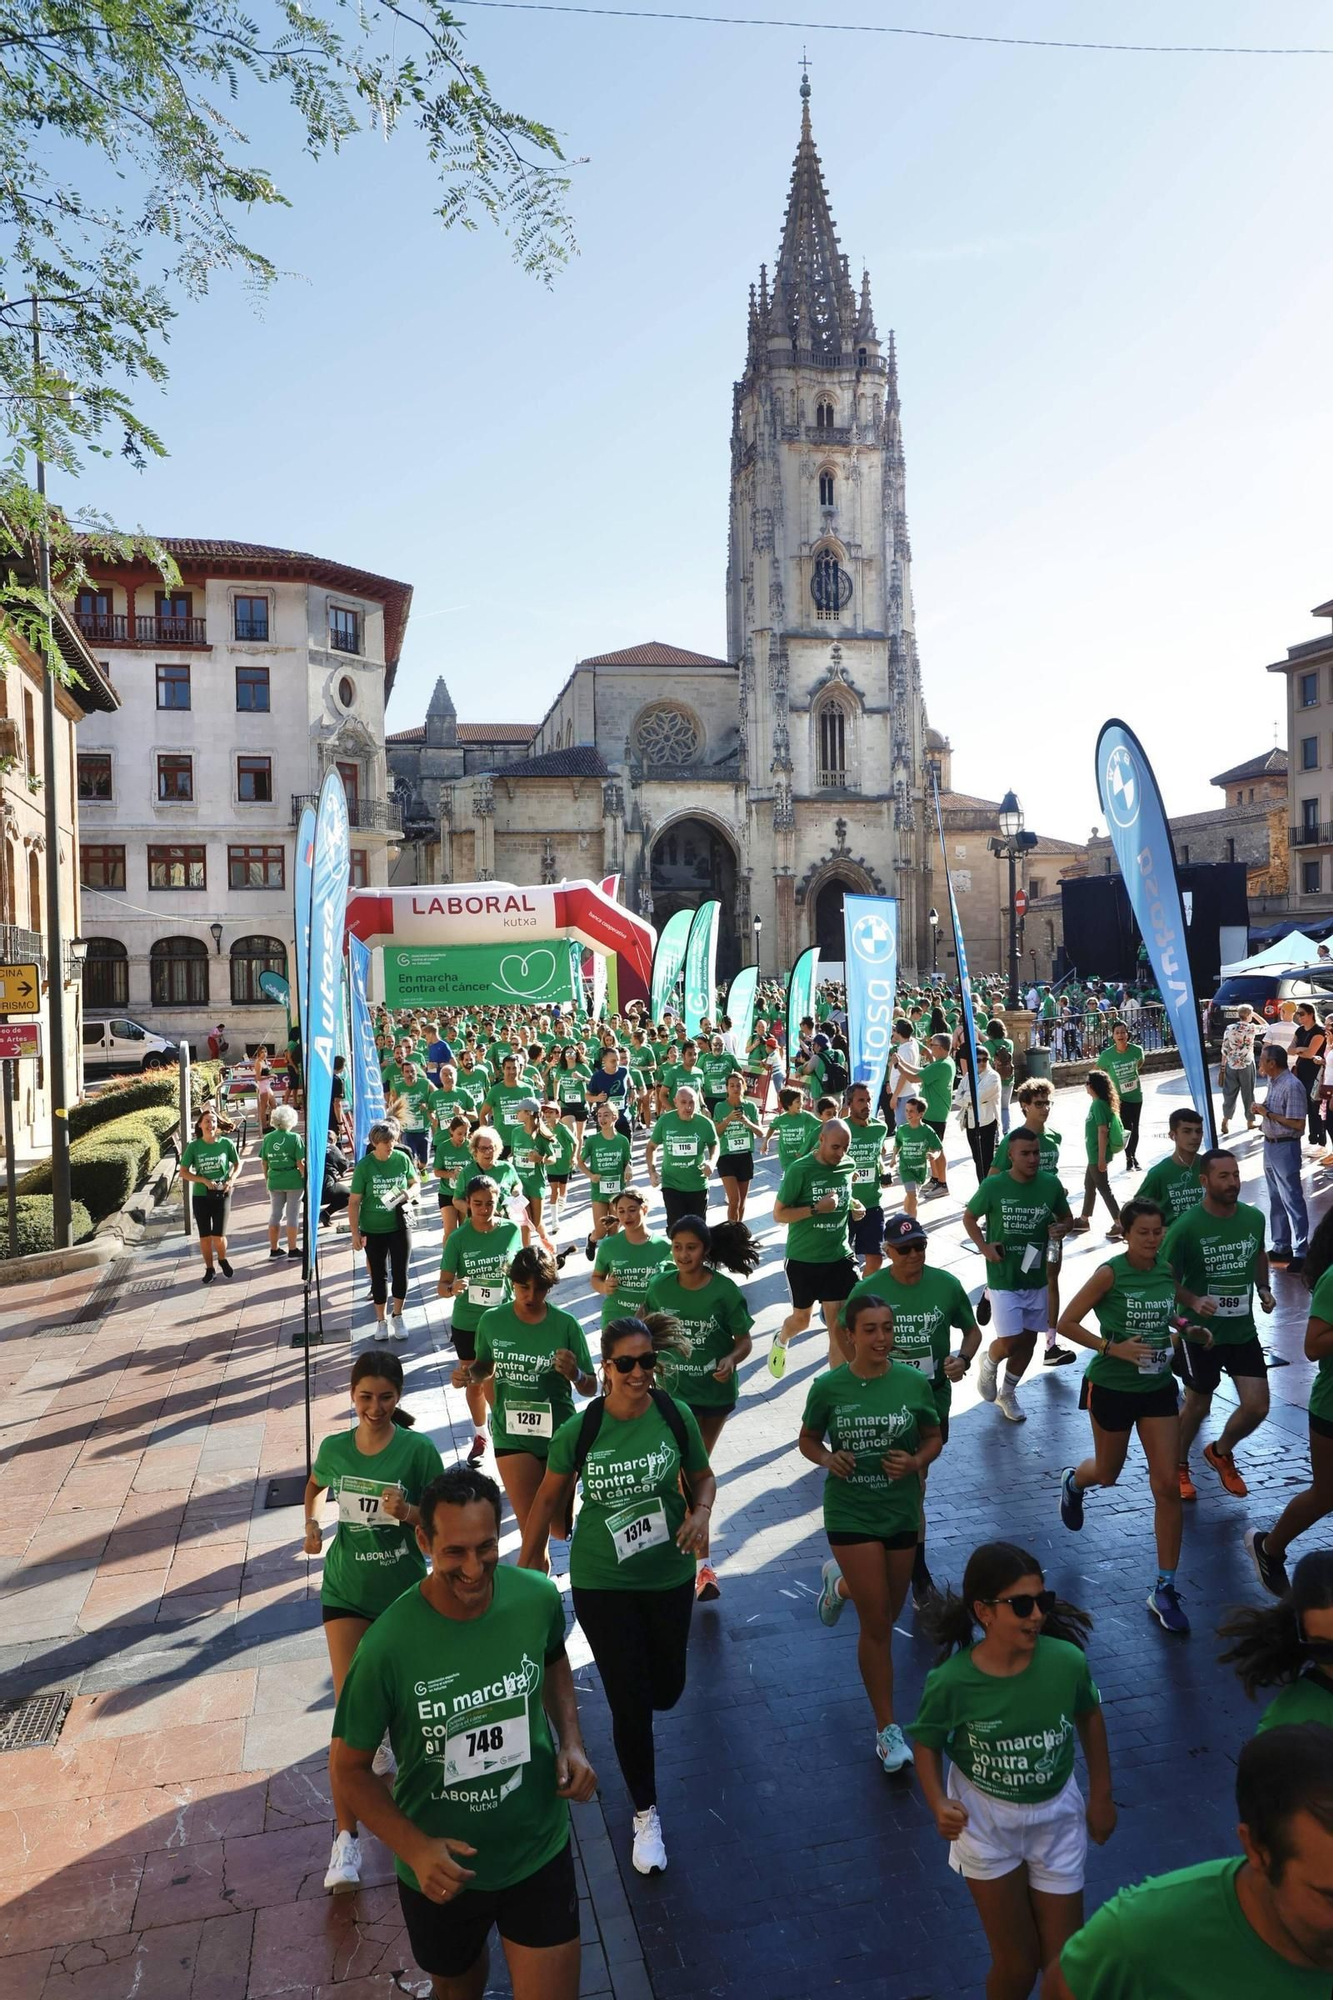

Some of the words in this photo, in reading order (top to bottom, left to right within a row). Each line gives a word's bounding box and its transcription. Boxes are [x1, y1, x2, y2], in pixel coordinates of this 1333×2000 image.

[412, 894, 536, 915] LABORAL
[503, 916, 537, 928] kutxa
[398, 973, 413, 983] En
[415, 972, 459, 983] marcha
[314, 897, 335, 1078] Autosa
[398, 984, 436, 994] contra
[438, 982, 449, 992] el
[452, 981, 490, 992] cáncer
[0, 1000, 35, 1011] RISMO
[862, 979, 892, 1084] utosa
[361, 1020, 388, 1124] utosa
[812, 1187, 824, 1195] En
[1169, 1190, 1181, 1198] En
[1171, 1196, 1196, 1205] contra
[1002, 1205, 1013, 1213] En
[1002, 1213, 1027, 1221] contra
[1010, 1220, 1037, 1230] cáncer
[1202, 1246, 1216, 1255] En
[1218, 1240, 1252, 1251] marcha
[464, 1259, 476, 1268] En
[1204, 1253, 1235, 1264] contra
[466, 1265, 493, 1275] contra
[1205, 1264, 1214, 1272] el
[1215, 1260, 1248, 1271] cáncer
[621, 1280, 649, 1288] cáncer
[480, 1288, 491, 1298] 75
[1126, 1298, 1142, 1310] En
[1218, 1297, 1240, 1308] 369
[896, 1312, 937, 1323] marcha
[1126, 1310, 1160, 1320] contra
[893, 1324, 915, 1333] ntra
[1126, 1319, 1138, 1328] el
[894, 1332, 931, 1344] cáncer
[493, 1348, 504, 1359] En
[507, 1351, 551, 1367] marcha
[495, 1369, 503, 1379] el
[506, 1370, 540, 1382] cáncer
[516, 1412, 542, 1425] 1287
[836, 1415, 851, 1428] En
[854, 1413, 905, 1427] marcha
[838, 1427, 876, 1440] contra
[842, 1440, 850, 1450] el
[852, 1437, 895, 1451] cáncer
[587, 1462, 605, 1476] En
[609, 1453, 667, 1474] marcha
[587, 1474, 635, 1490] contra
[590, 1490, 602, 1501] el
[606, 1482, 657, 1499] cáncer
[358, 1497, 379, 1513] 177
[623, 1517, 652, 1543] 1374
[355, 1550, 395, 1561] LABORAL
[417, 1700, 447, 1720] En
[452, 1674, 528, 1712] marcha
[425, 1740, 440, 1754] el
[465, 1726, 504, 1757] 748
[967, 1733, 991, 1752] En
[996, 1730, 1064, 1752] marcha
[973, 1750, 1029, 1770] contra
[972, 1763, 987, 1779] el
[991, 1770, 1054, 1787] cáncer
[431, 1788, 498, 1803] LABORAL
[469, 1801, 498, 1812] kutxa
